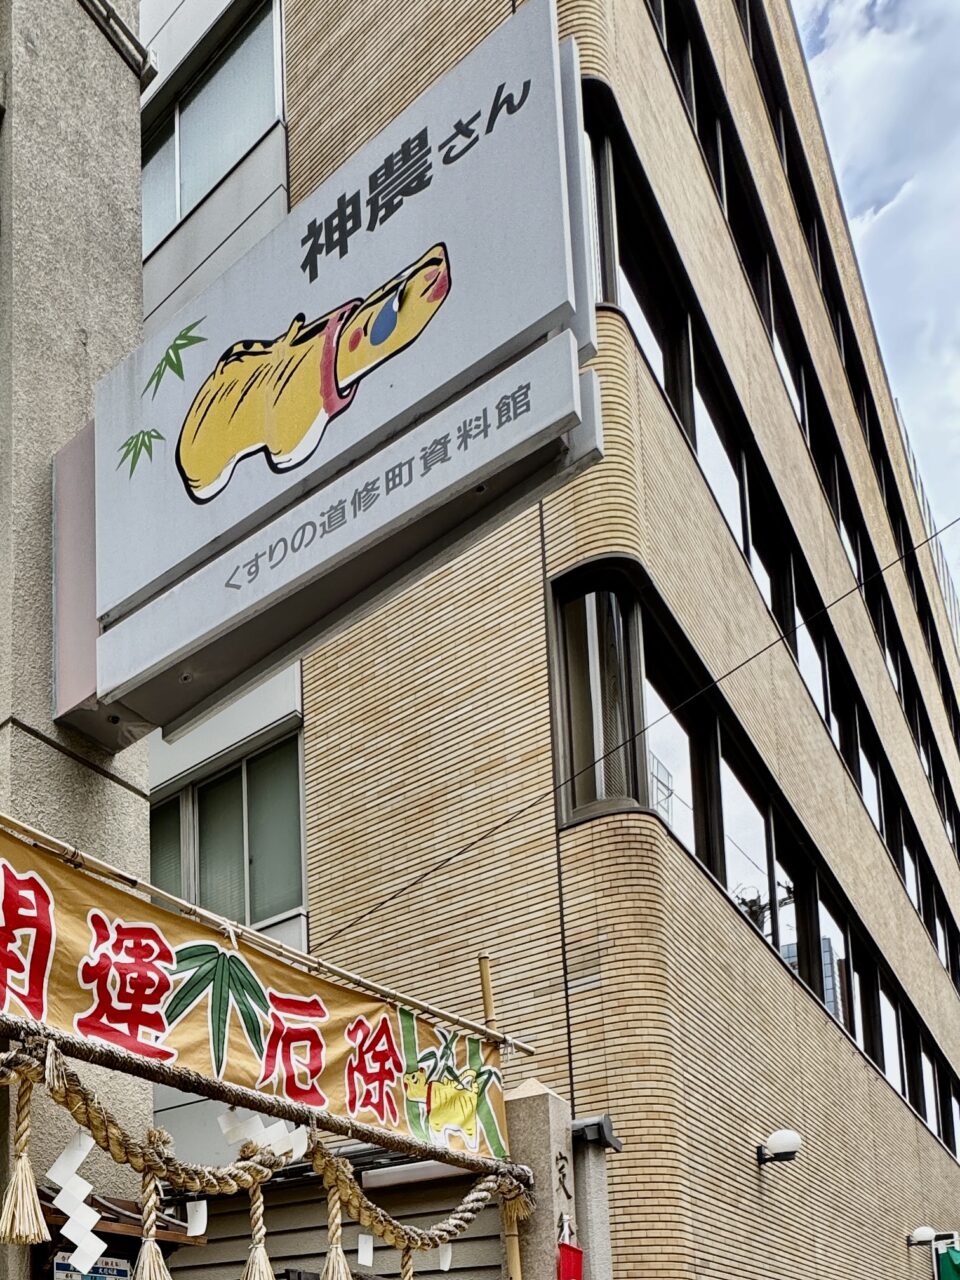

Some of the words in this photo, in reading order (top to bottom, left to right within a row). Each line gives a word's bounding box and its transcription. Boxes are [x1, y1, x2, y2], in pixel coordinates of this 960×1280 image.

[300, 77, 531, 282] 神農さん
[224, 381, 533, 592] くすりの道修町資料館
